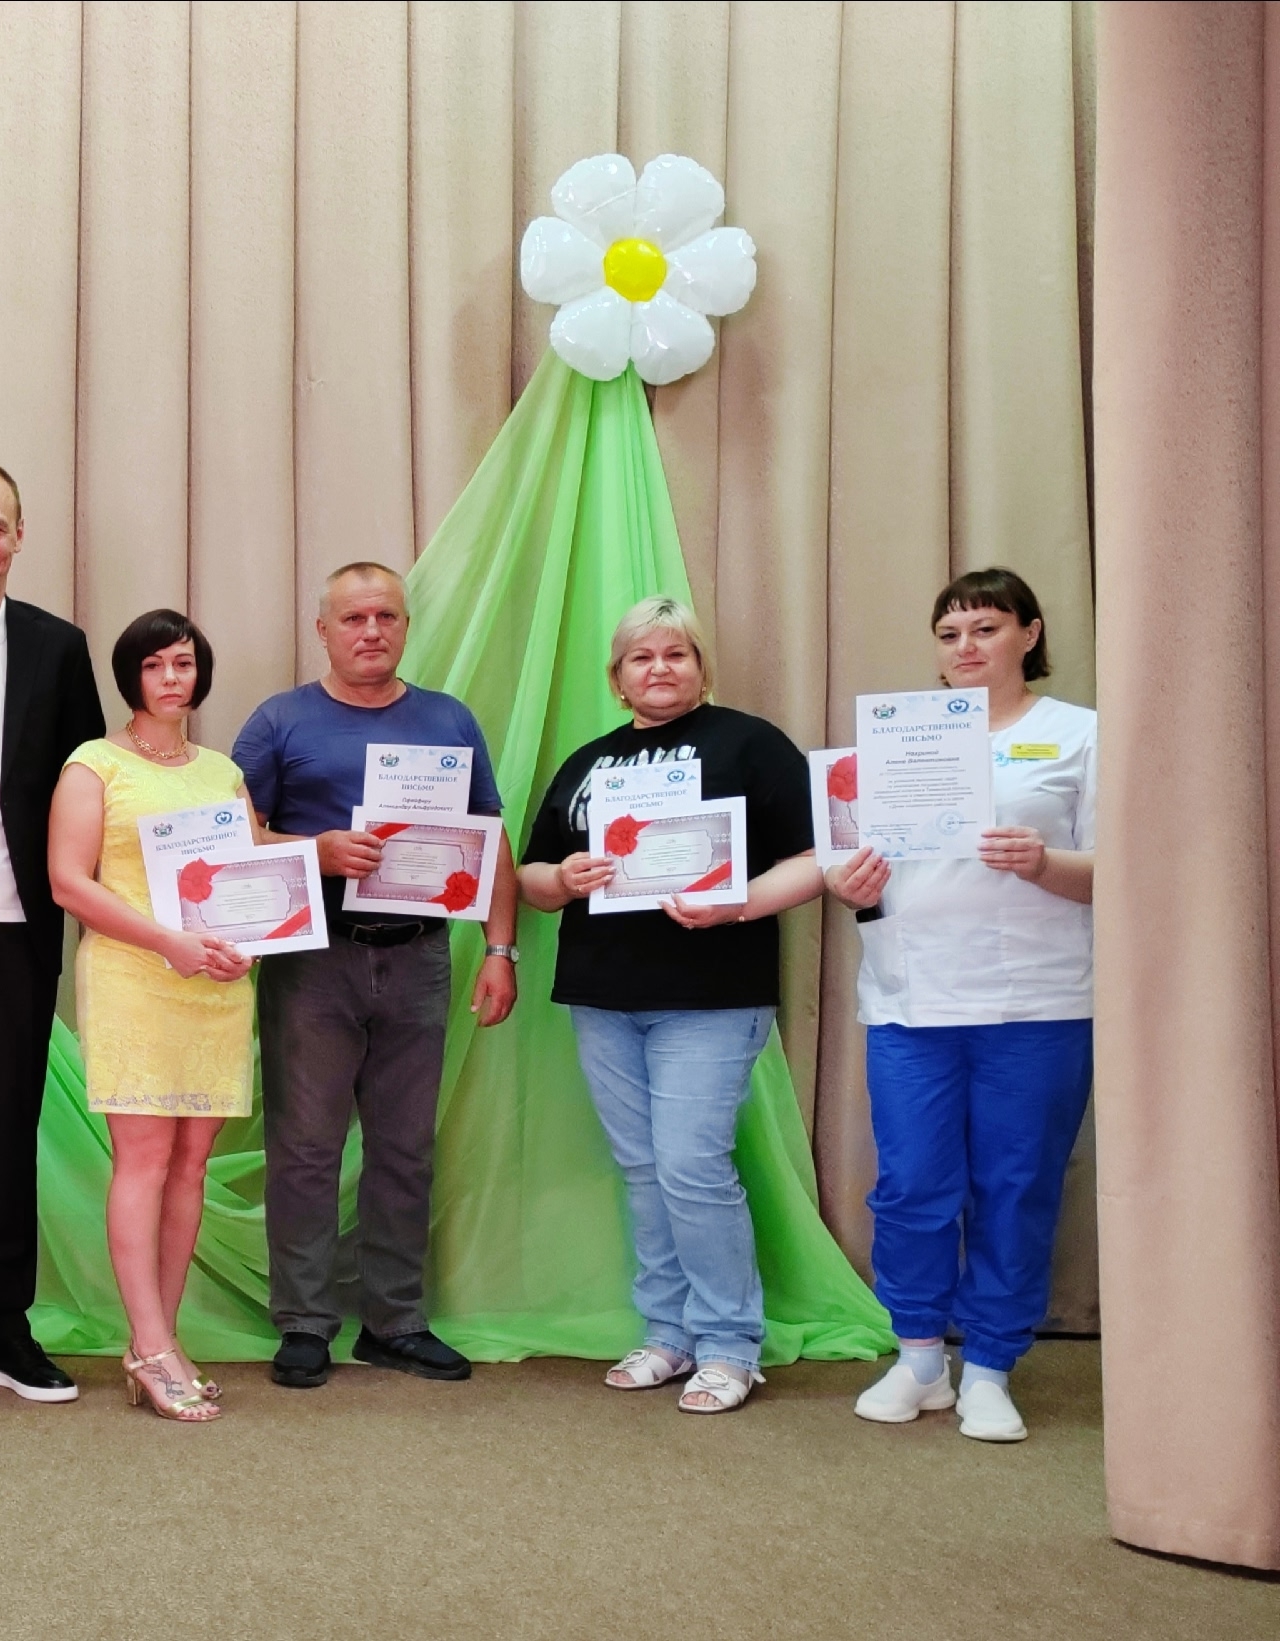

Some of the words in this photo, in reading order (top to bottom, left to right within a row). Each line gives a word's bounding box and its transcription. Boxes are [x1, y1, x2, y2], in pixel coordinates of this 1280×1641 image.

[872, 721, 972, 735] БЛАГОДАРСТВЕННОЕ
[901, 733, 942, 743] ПИСЬМО
[378, 773, 458, 783] БЛАГОДАРСТВЕННОЕ
[401, 783, 435, 791] ПИСЬМО
[605, 788, 687, 803] БЛАГОДАРСТВЕННОЕ
[629, 801, 663, 810] ПИСЬМО
[155, 830, 238, 852] БЛАГОДАРСТВЕННОЕ
[180, 844, 216, 856] ПИСЬМО
